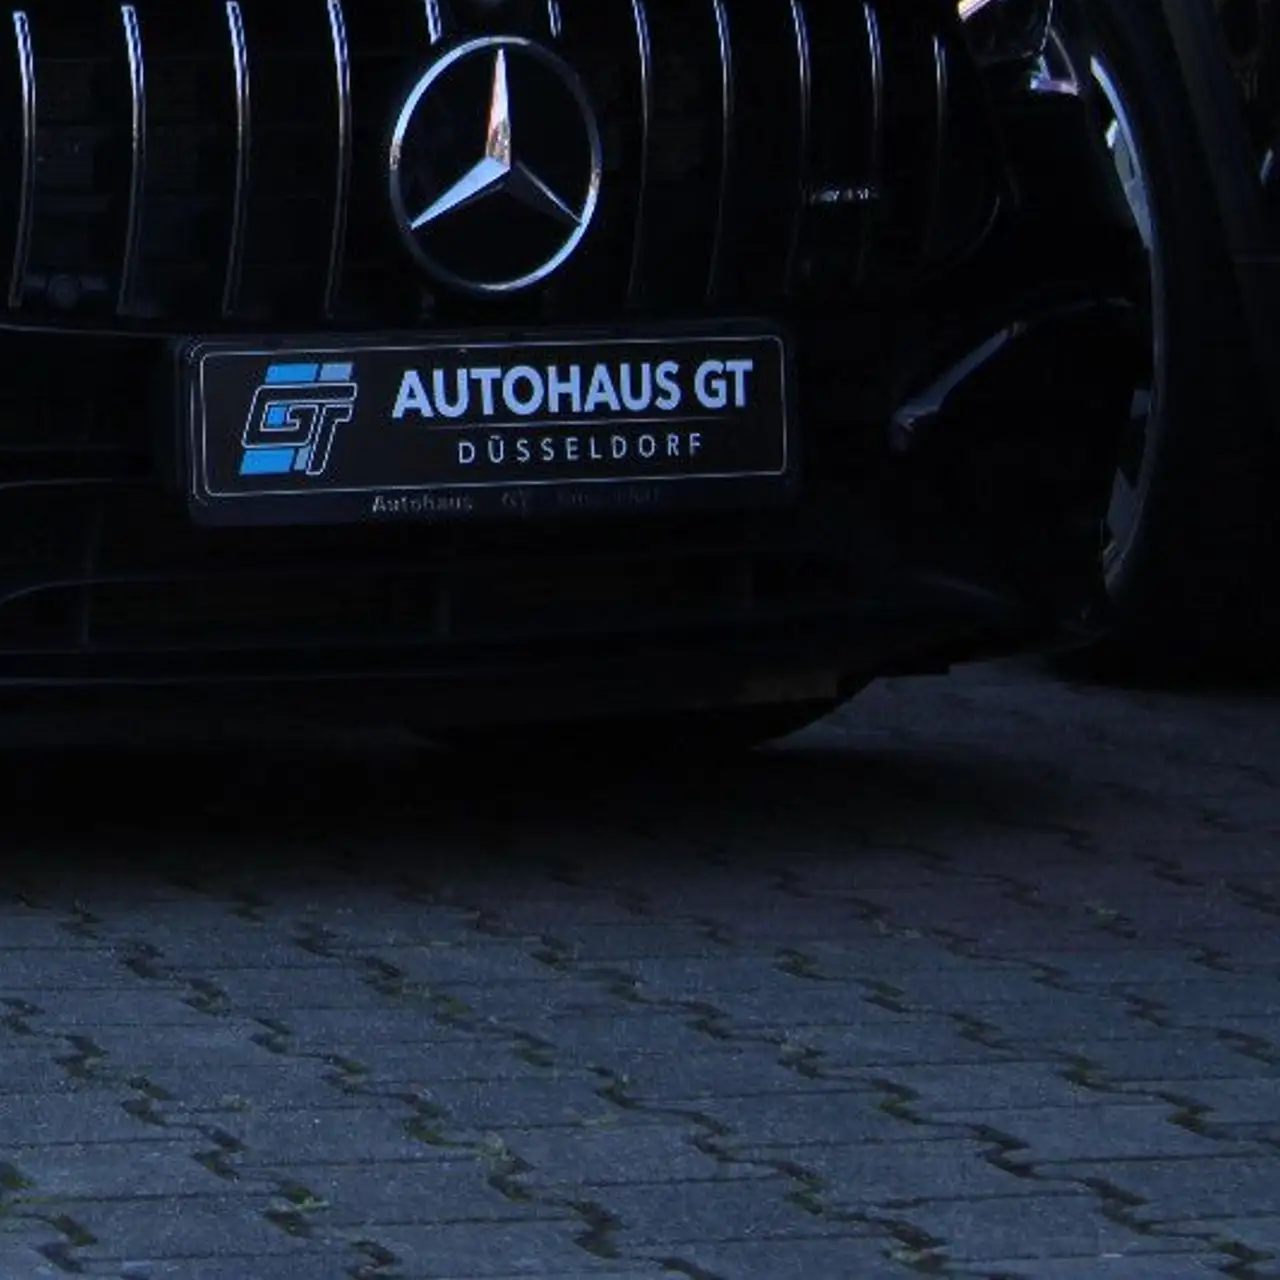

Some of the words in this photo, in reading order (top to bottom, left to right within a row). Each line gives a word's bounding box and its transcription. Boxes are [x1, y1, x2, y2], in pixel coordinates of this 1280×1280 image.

[391, 359, 682, 418] AUTOHAUS
[693, 358, 754, 409] GT
[458, 433, 701, 464] DÜSSELDORF
